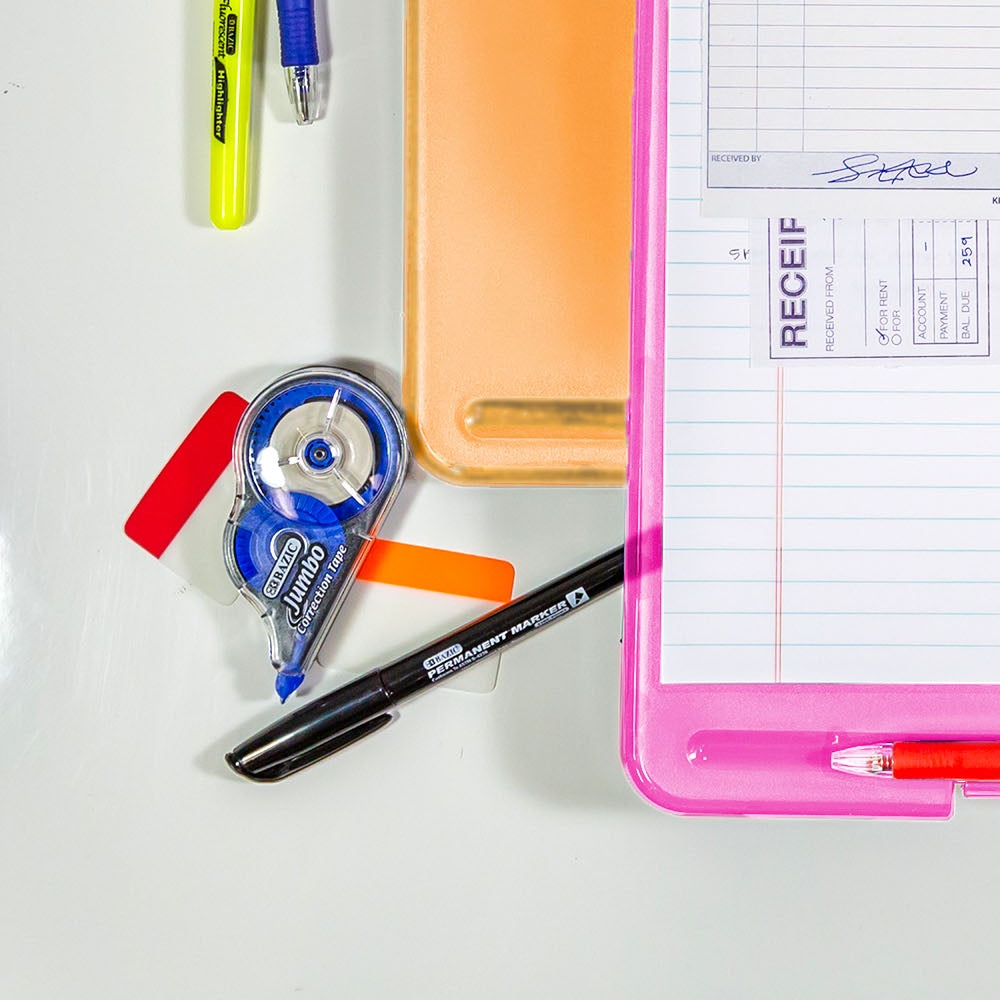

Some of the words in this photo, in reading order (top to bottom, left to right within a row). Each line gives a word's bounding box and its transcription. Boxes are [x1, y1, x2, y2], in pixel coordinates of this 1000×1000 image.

[215, 70, 226, 138] Highlighter
[962, 237, 972, 266] 259
[826, 267, 834, 298] FROM
[879, 280, 888, 307] RENT
[826, 300, 834, 351] RECEIVED
[880, 309, 888, 331] FOR
[919, 286, 927, 339] ACCOUNT
[940, 291, 948, 339] PAYMENT
[277, 543, 298, 580] BAZIC
[327, 544, 348, 573] Tape
[283, 544, 326, 617] Jumbo
[428, 631, 509, 679] PERMANENT
[510, 600, 567, 635] MARKER
